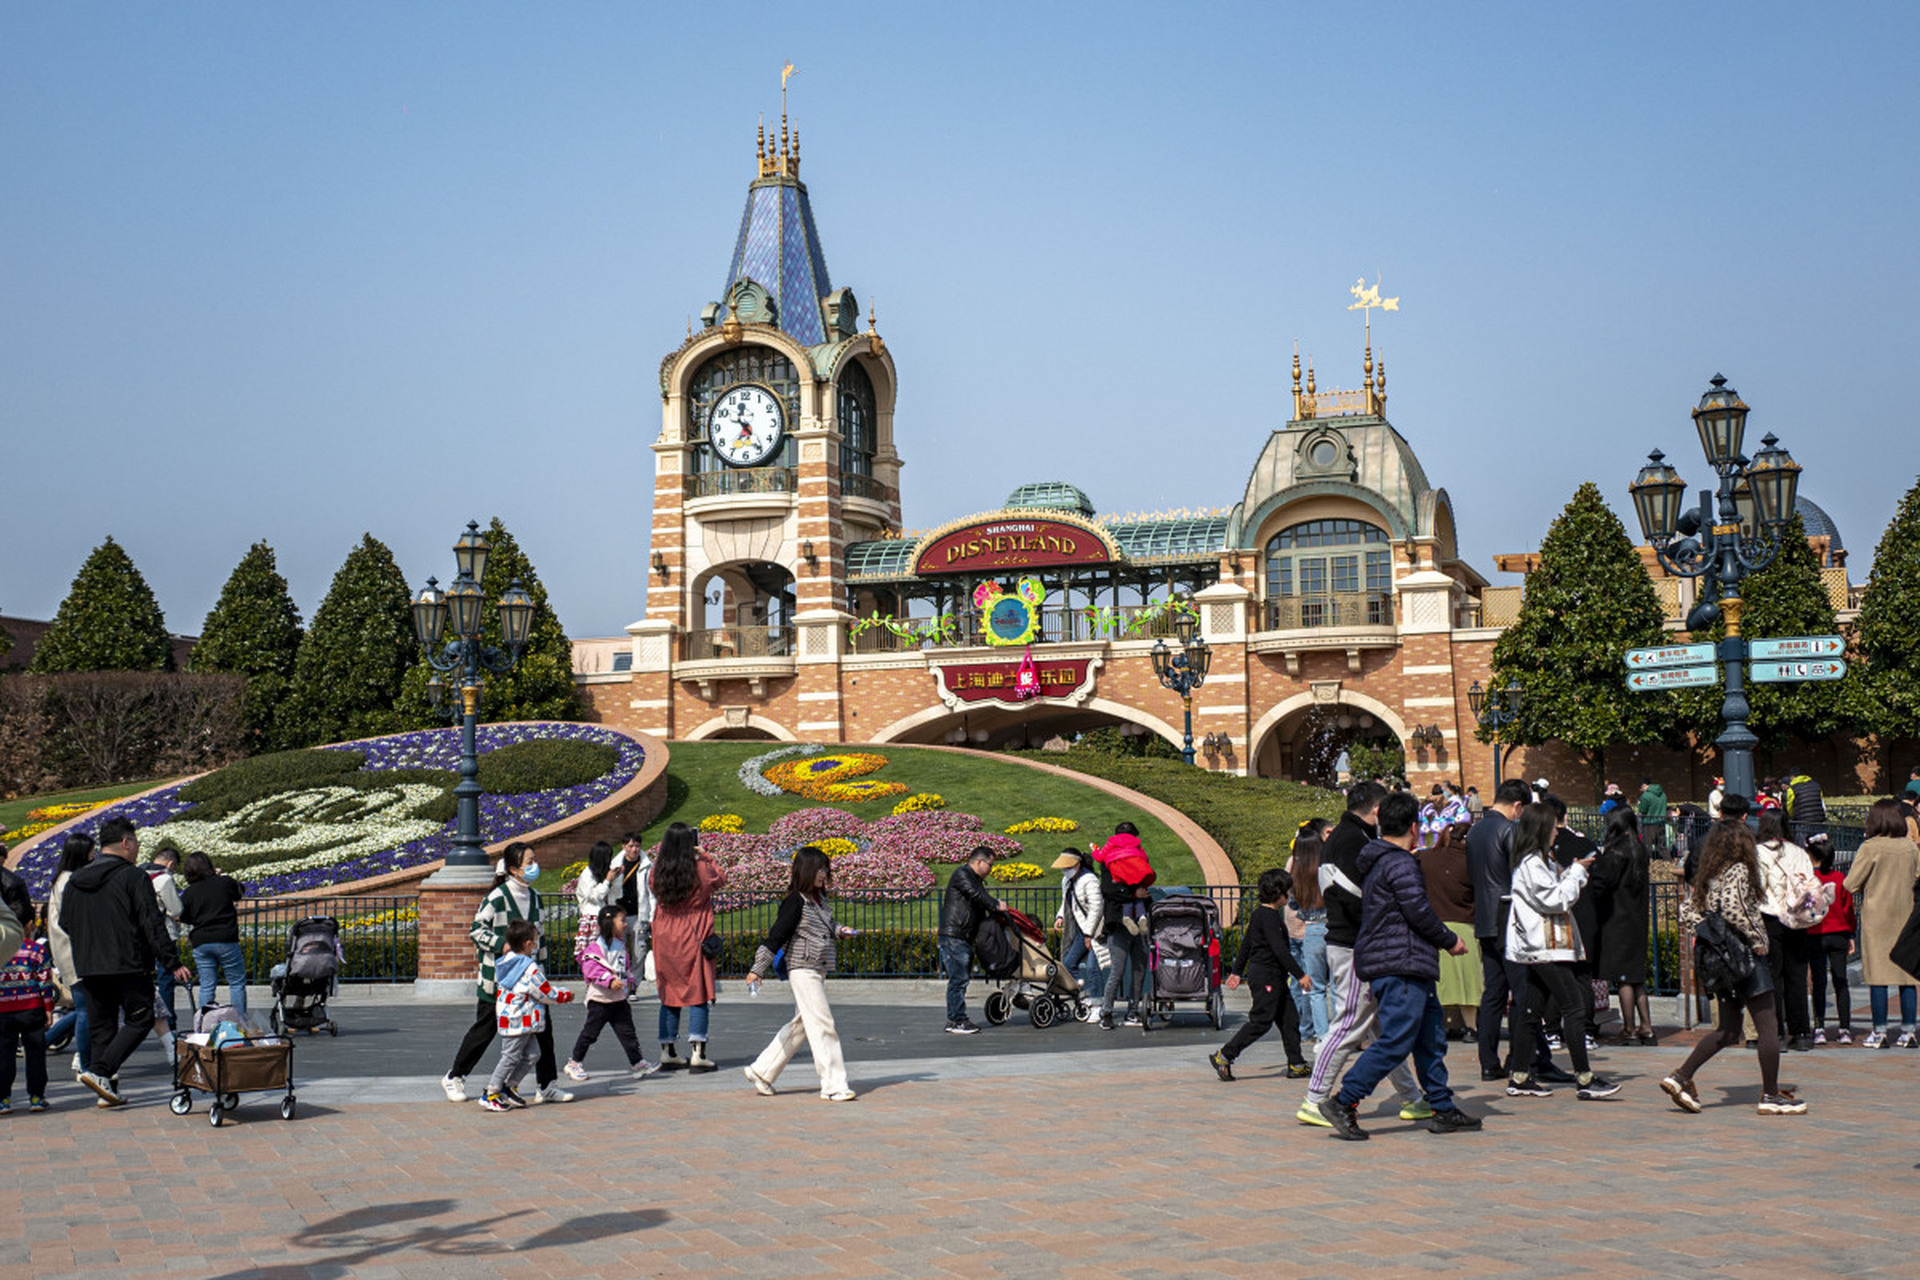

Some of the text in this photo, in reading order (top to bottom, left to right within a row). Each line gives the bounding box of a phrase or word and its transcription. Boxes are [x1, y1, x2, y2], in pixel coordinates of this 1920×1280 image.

[729, 396, 736, 405] 11
[741, 391, 751, 401] 12
[757, 394, 761, 403] 1
[718, 408, 729, 418] 10
[766, 404, 773, 413] 2
[714, 424, 721, 434] 9
[719, 438, 726, 447] 8
[766, 434, 773, 443] 4
[730, 447, 736, 457] 7
[742, 450, 749, 460] 6
[986, 524, 1035, 535] SHANGHAI
[947, 535, 1077, 563] DISNEYLAND
